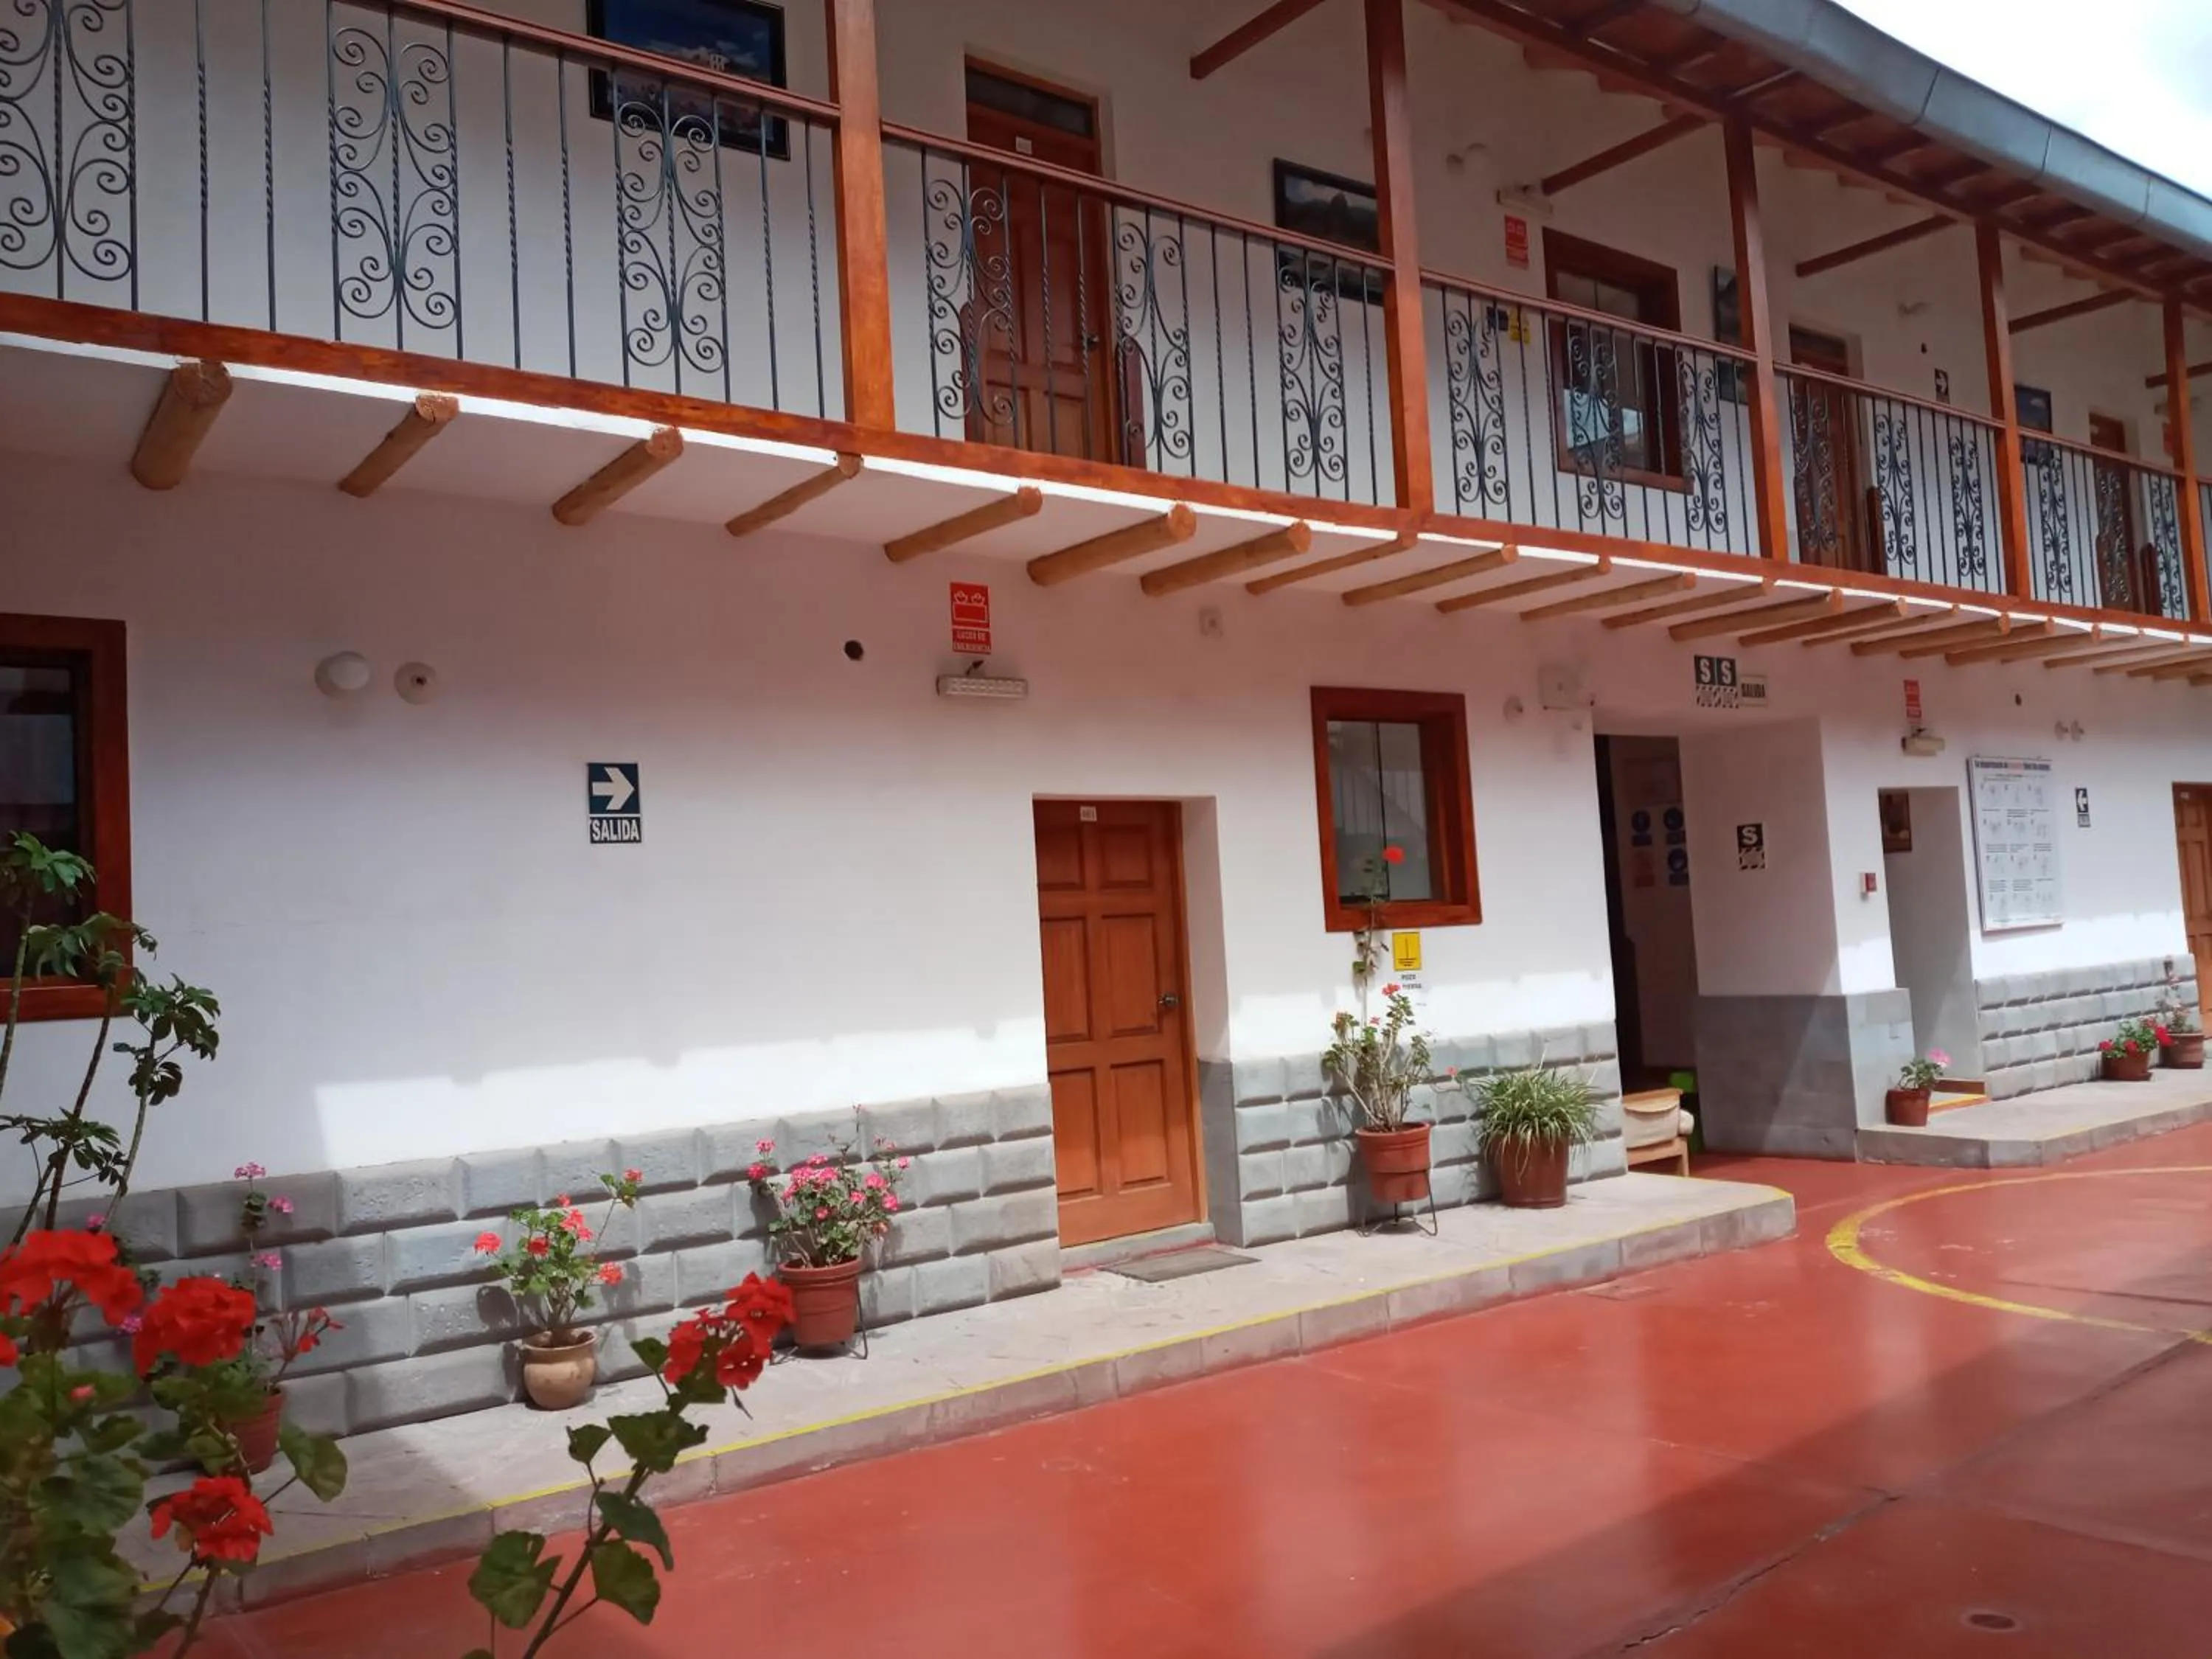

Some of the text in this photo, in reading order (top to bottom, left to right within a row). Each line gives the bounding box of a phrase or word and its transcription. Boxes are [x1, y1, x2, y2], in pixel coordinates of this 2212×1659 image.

[1700, 658, 1711, 684] S
[1720, 660, 1732, 685] S
[592, 818, 640, 841] SALIDA
[1742, 827, 1758, 845] S
